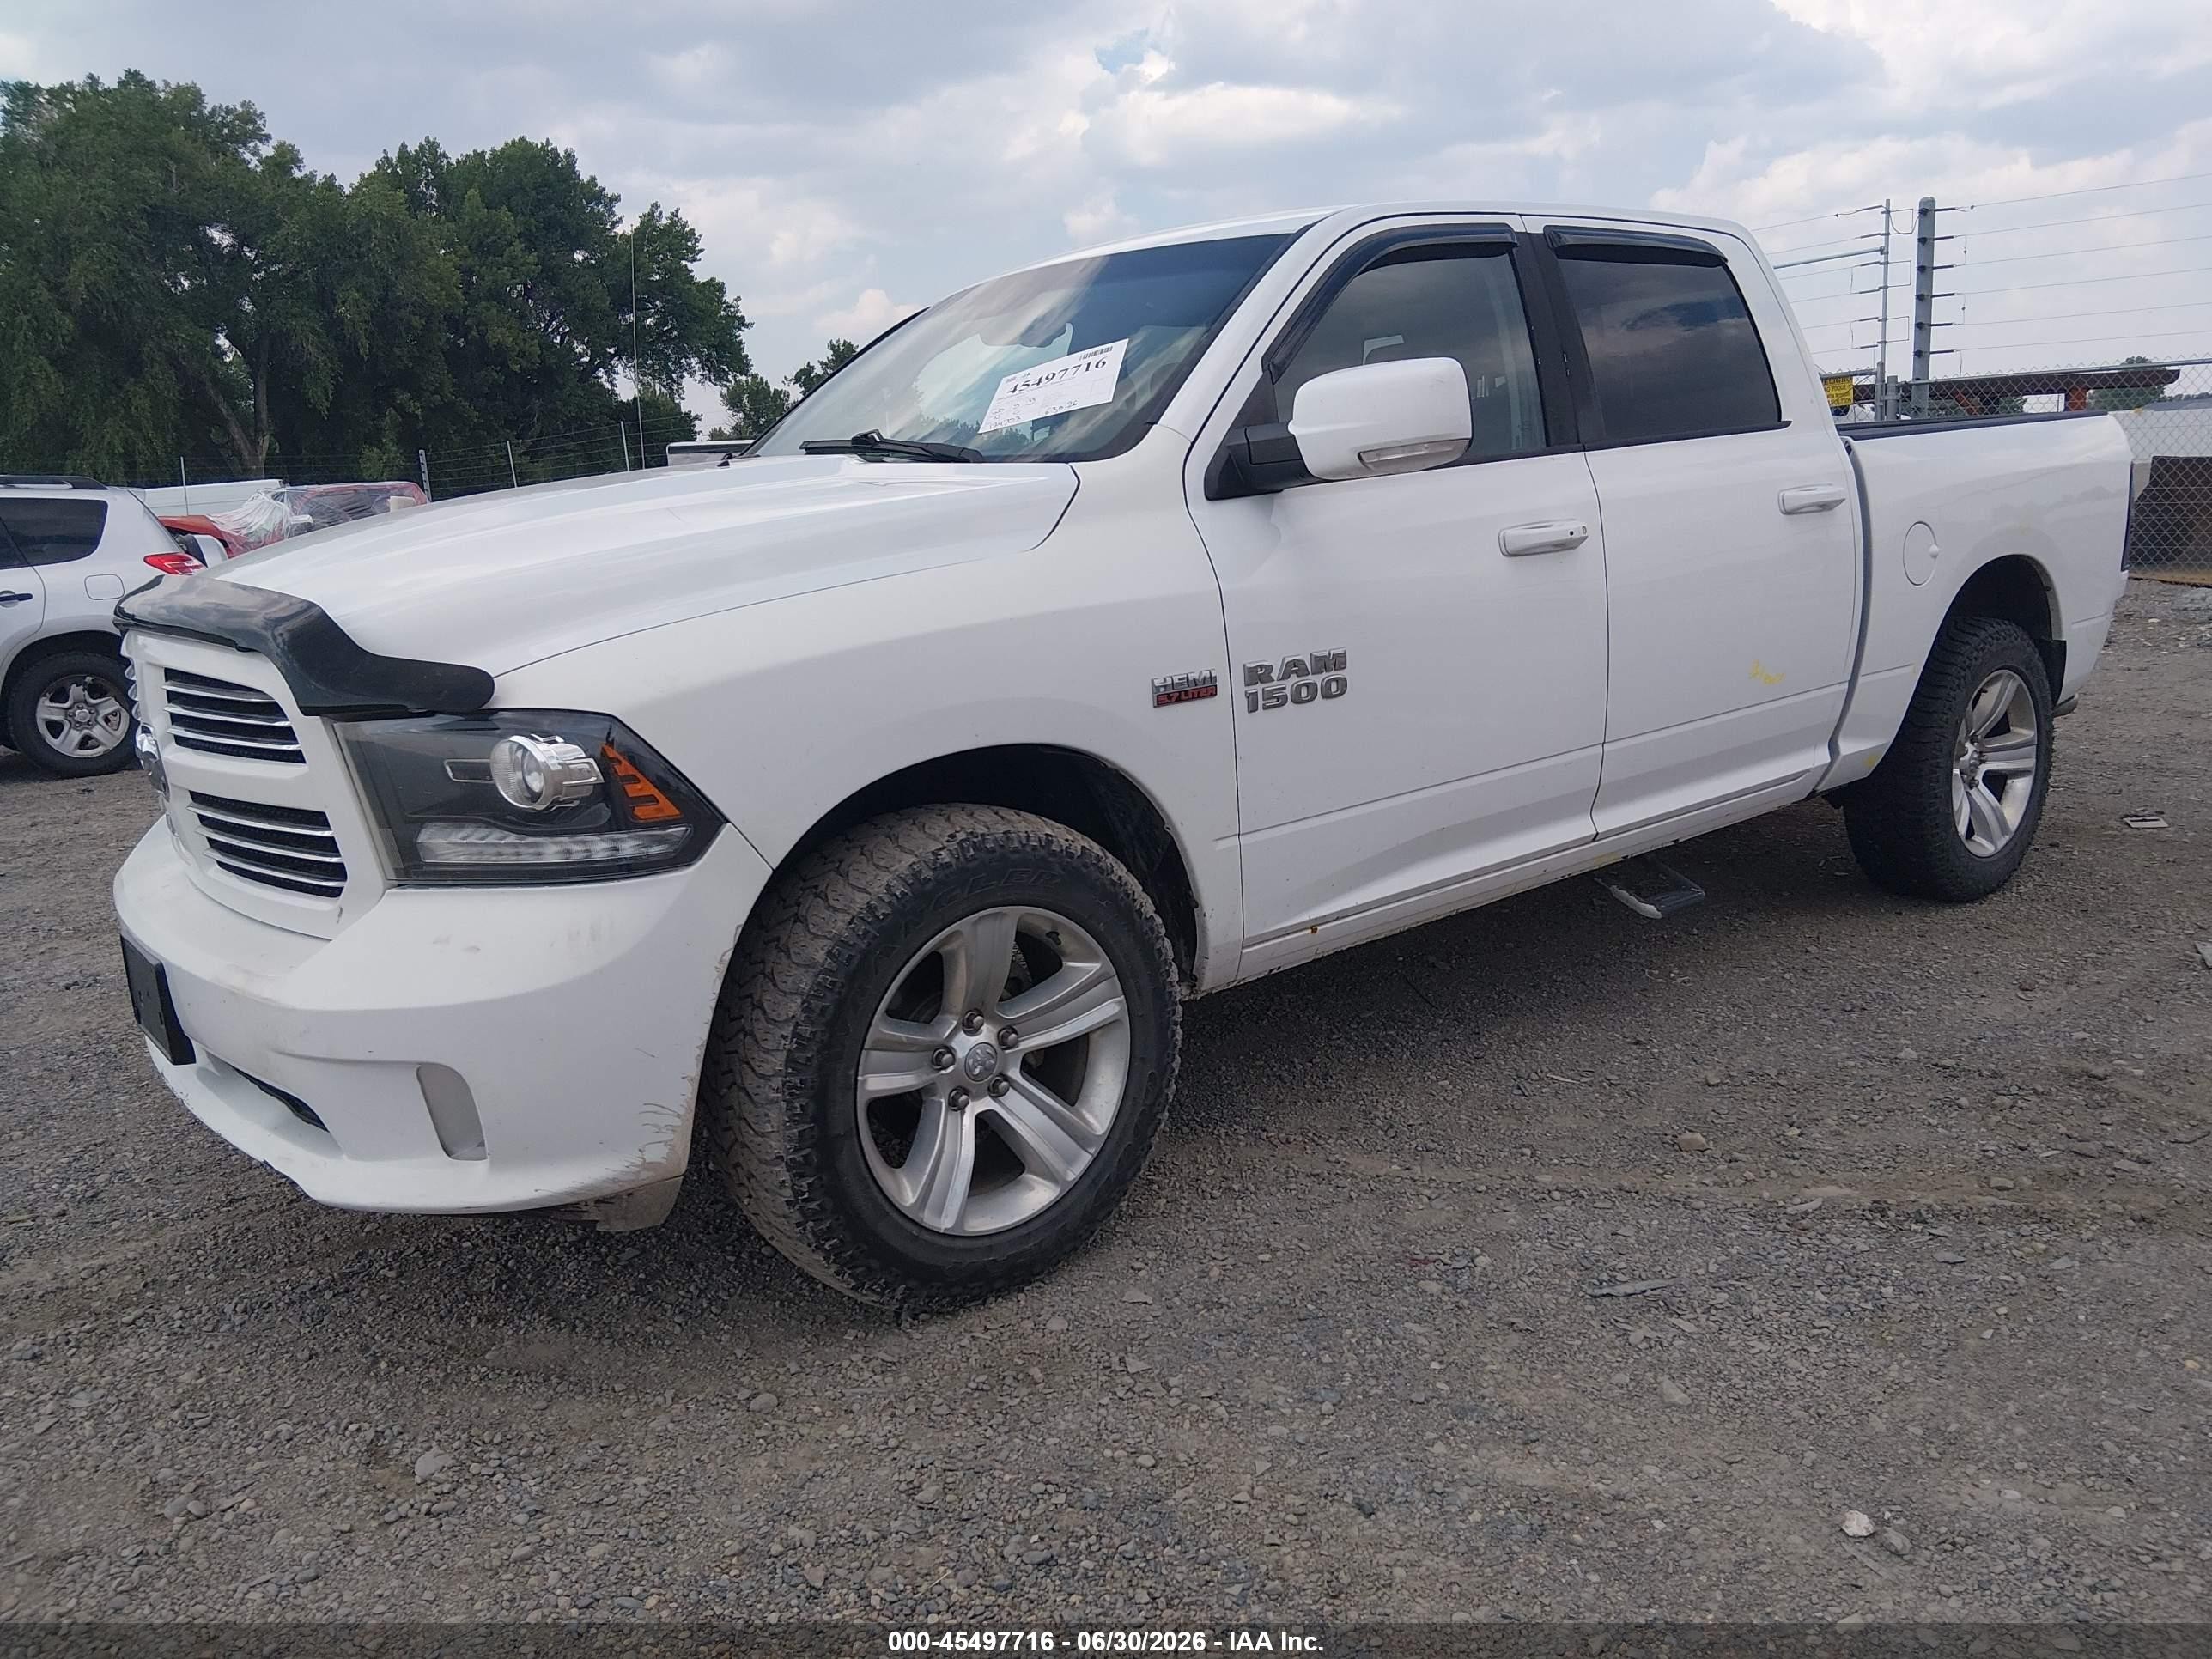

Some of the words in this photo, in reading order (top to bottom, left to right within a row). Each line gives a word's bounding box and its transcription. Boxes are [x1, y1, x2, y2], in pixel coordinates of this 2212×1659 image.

[1007, 356, 1108, 393] 45497716
[1152, 669, 1218, 694] HEMI
[1243, 647, 1347, 687] RAM
[1158, 690, 1181, 705] 5.7
[1181, 685, 1216, 702] LITER
[1245, 674, 1347, 714] 1500
